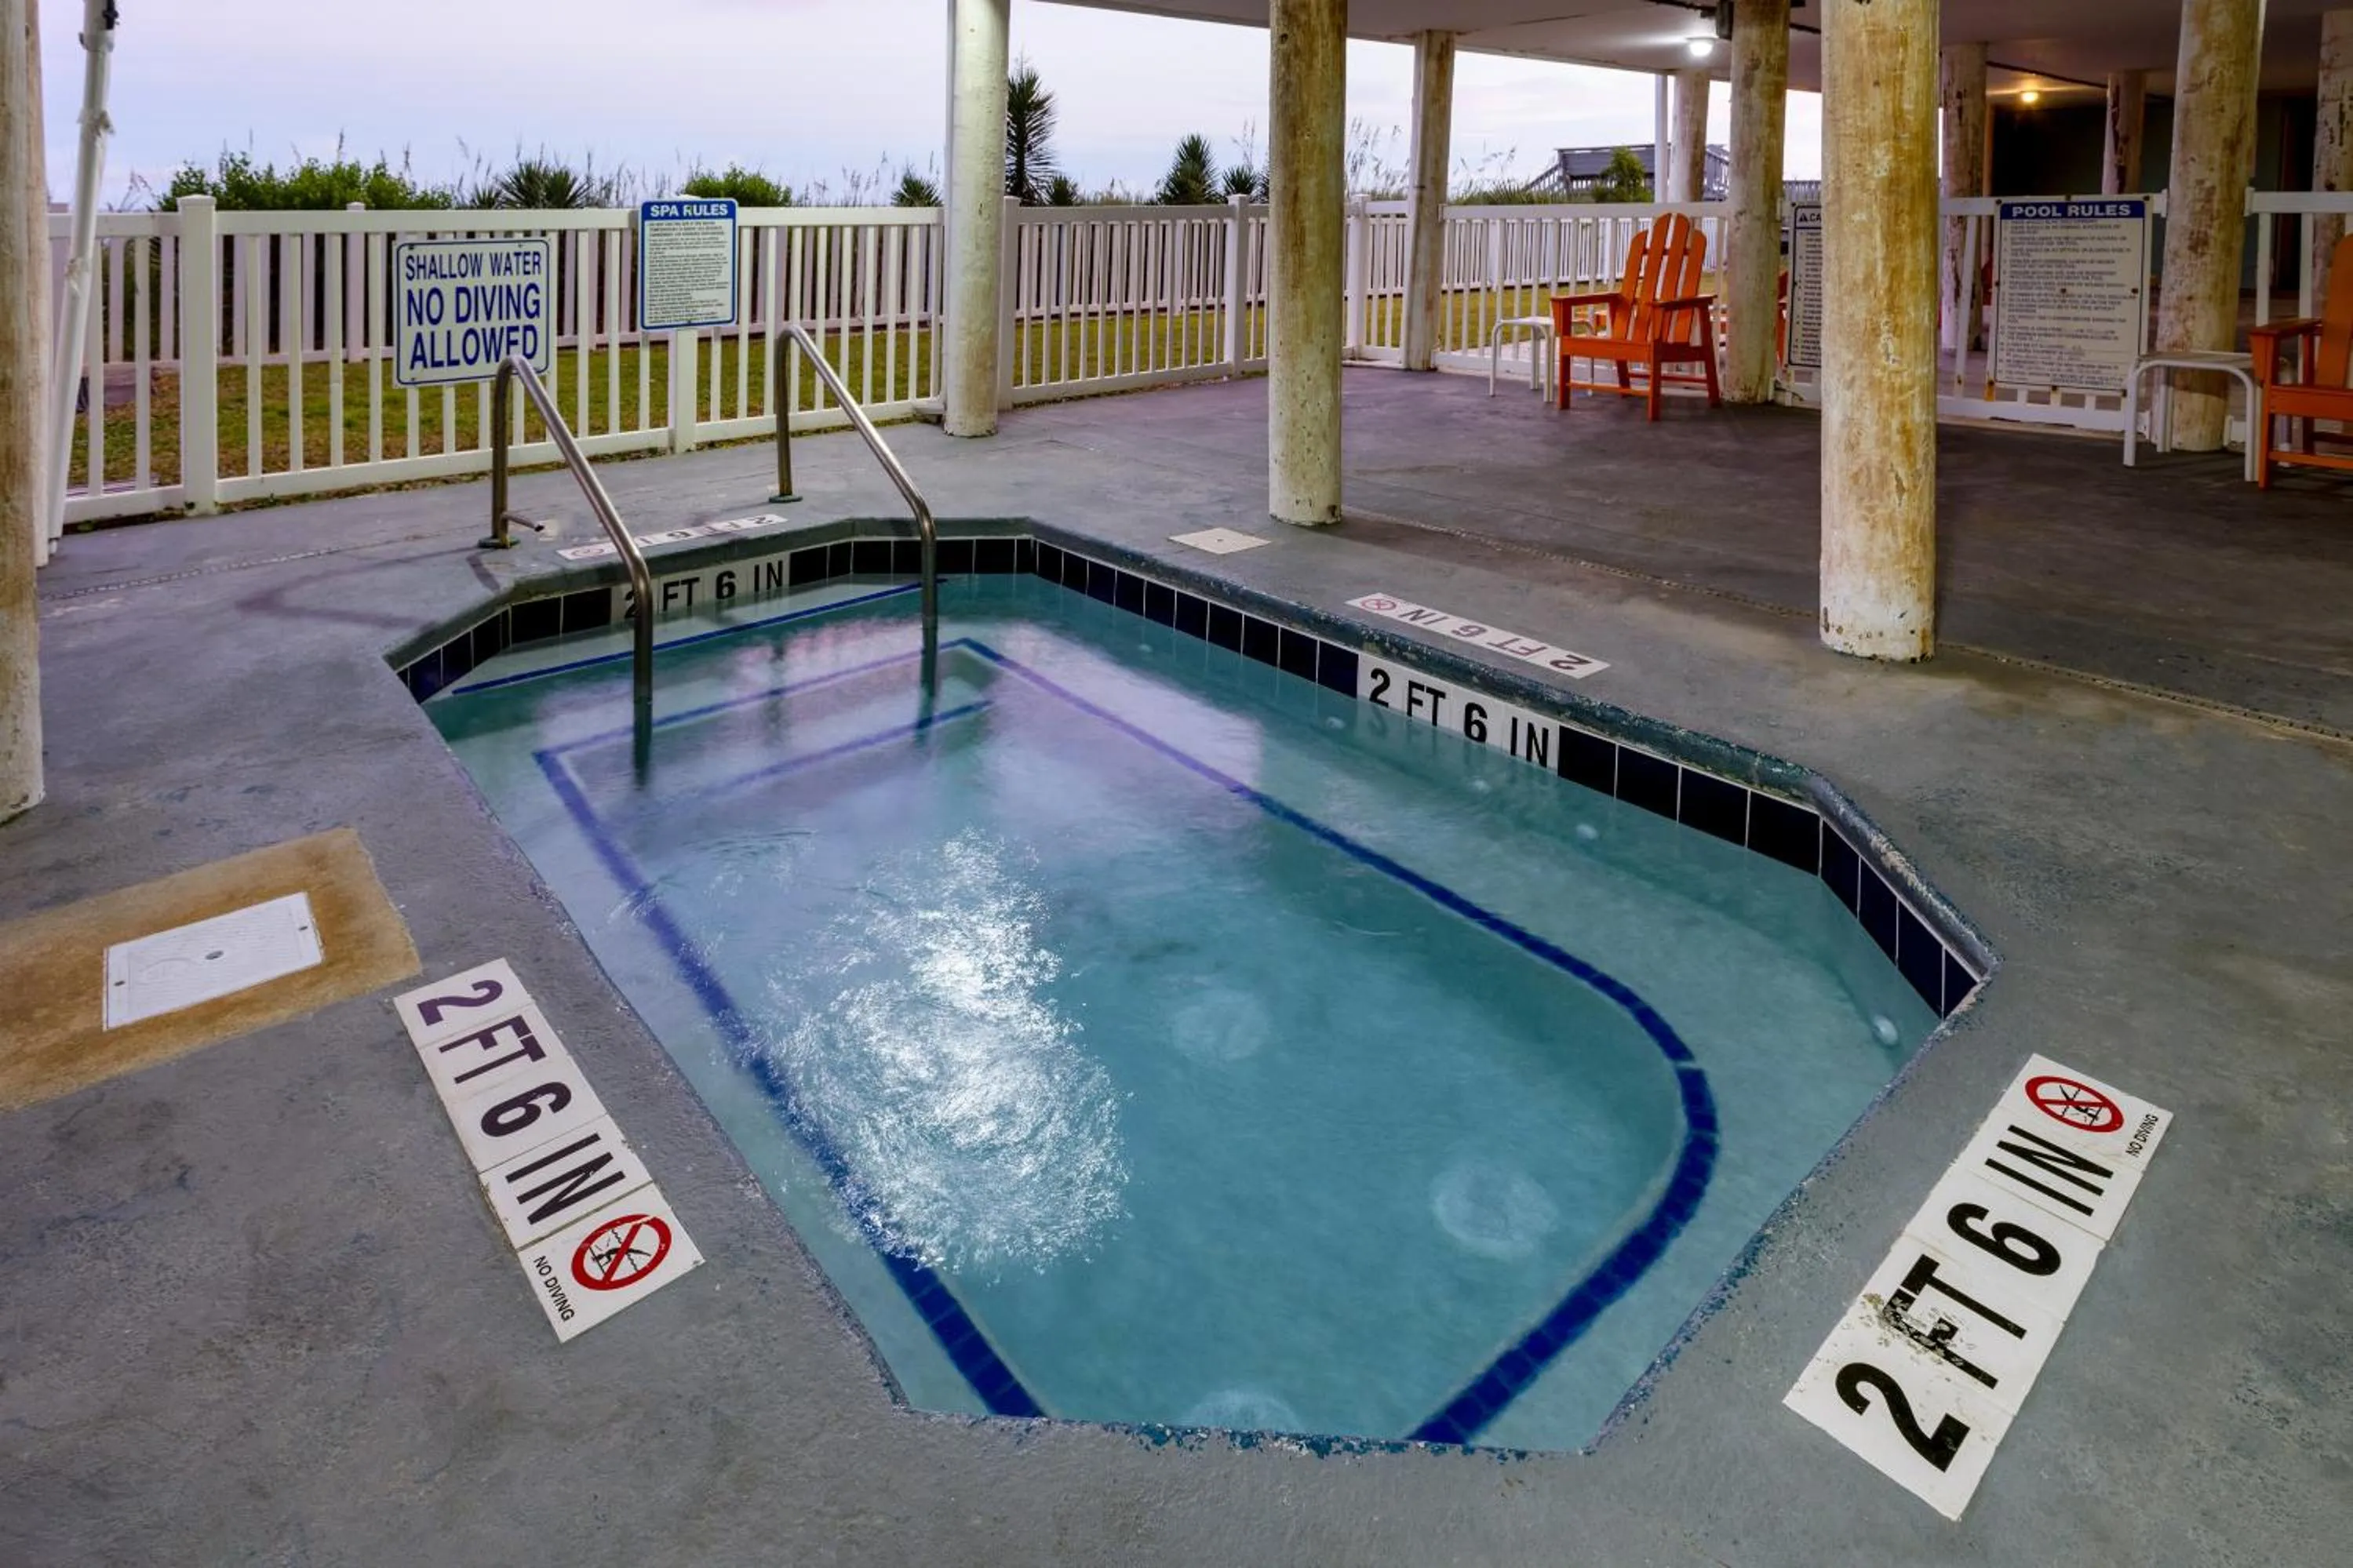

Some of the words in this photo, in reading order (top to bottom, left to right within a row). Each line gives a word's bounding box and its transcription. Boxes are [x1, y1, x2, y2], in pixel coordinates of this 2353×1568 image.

[650, 205, 679, 216] SPA
[683, 204, 728, 216] RULES
[2012, 206, 2061, 217] POOL
[2067, 205, 2132, 216] RULES
[406, 253, 483, 281] SHALLOW
[490, 251, 541, 276] WATER
[407, 288, 443, 326] NO
[456, 283, 540, 323] DIVING
[410, 325, 538, 370] ALLOWED
[662, 577, 700, 612] FT
[716, 570, 736, 600] 6
[754, 560, 783, 592] IN
[1401, 609, 1448, 625] IN
[1451, 624, 1487, 638] 6
[1487, 637, 1547, 657] FT
[1549, 654, 1593, 670] 2
[1369, 668, 1391, 708] 2
[1406, 680, 1446, 726] FT
[1463, 702, 1488, 743] 6
[1510, 717, 1549, 767] IN
[417, 979, 504, 1027] 2
[439, 1014, 546, 1084] FT
[481, 1082, 572, 1137] 6
[2125, 1138, 2142, 1157] NO
[2139, 1113, 2159, 1145] DIVING
[505, 1132, 626, 1226] IN
[1985, 1123, 2114, 1218] IN
[1947, 1202, 2062, 1277] 6
[534, 1255, 553, 1276] NO
[544, 1276, 575, 1323] DIVING
[1883, 1253, 2027, 1391] FT
[1834, 1362, 1971, 1473] 2
